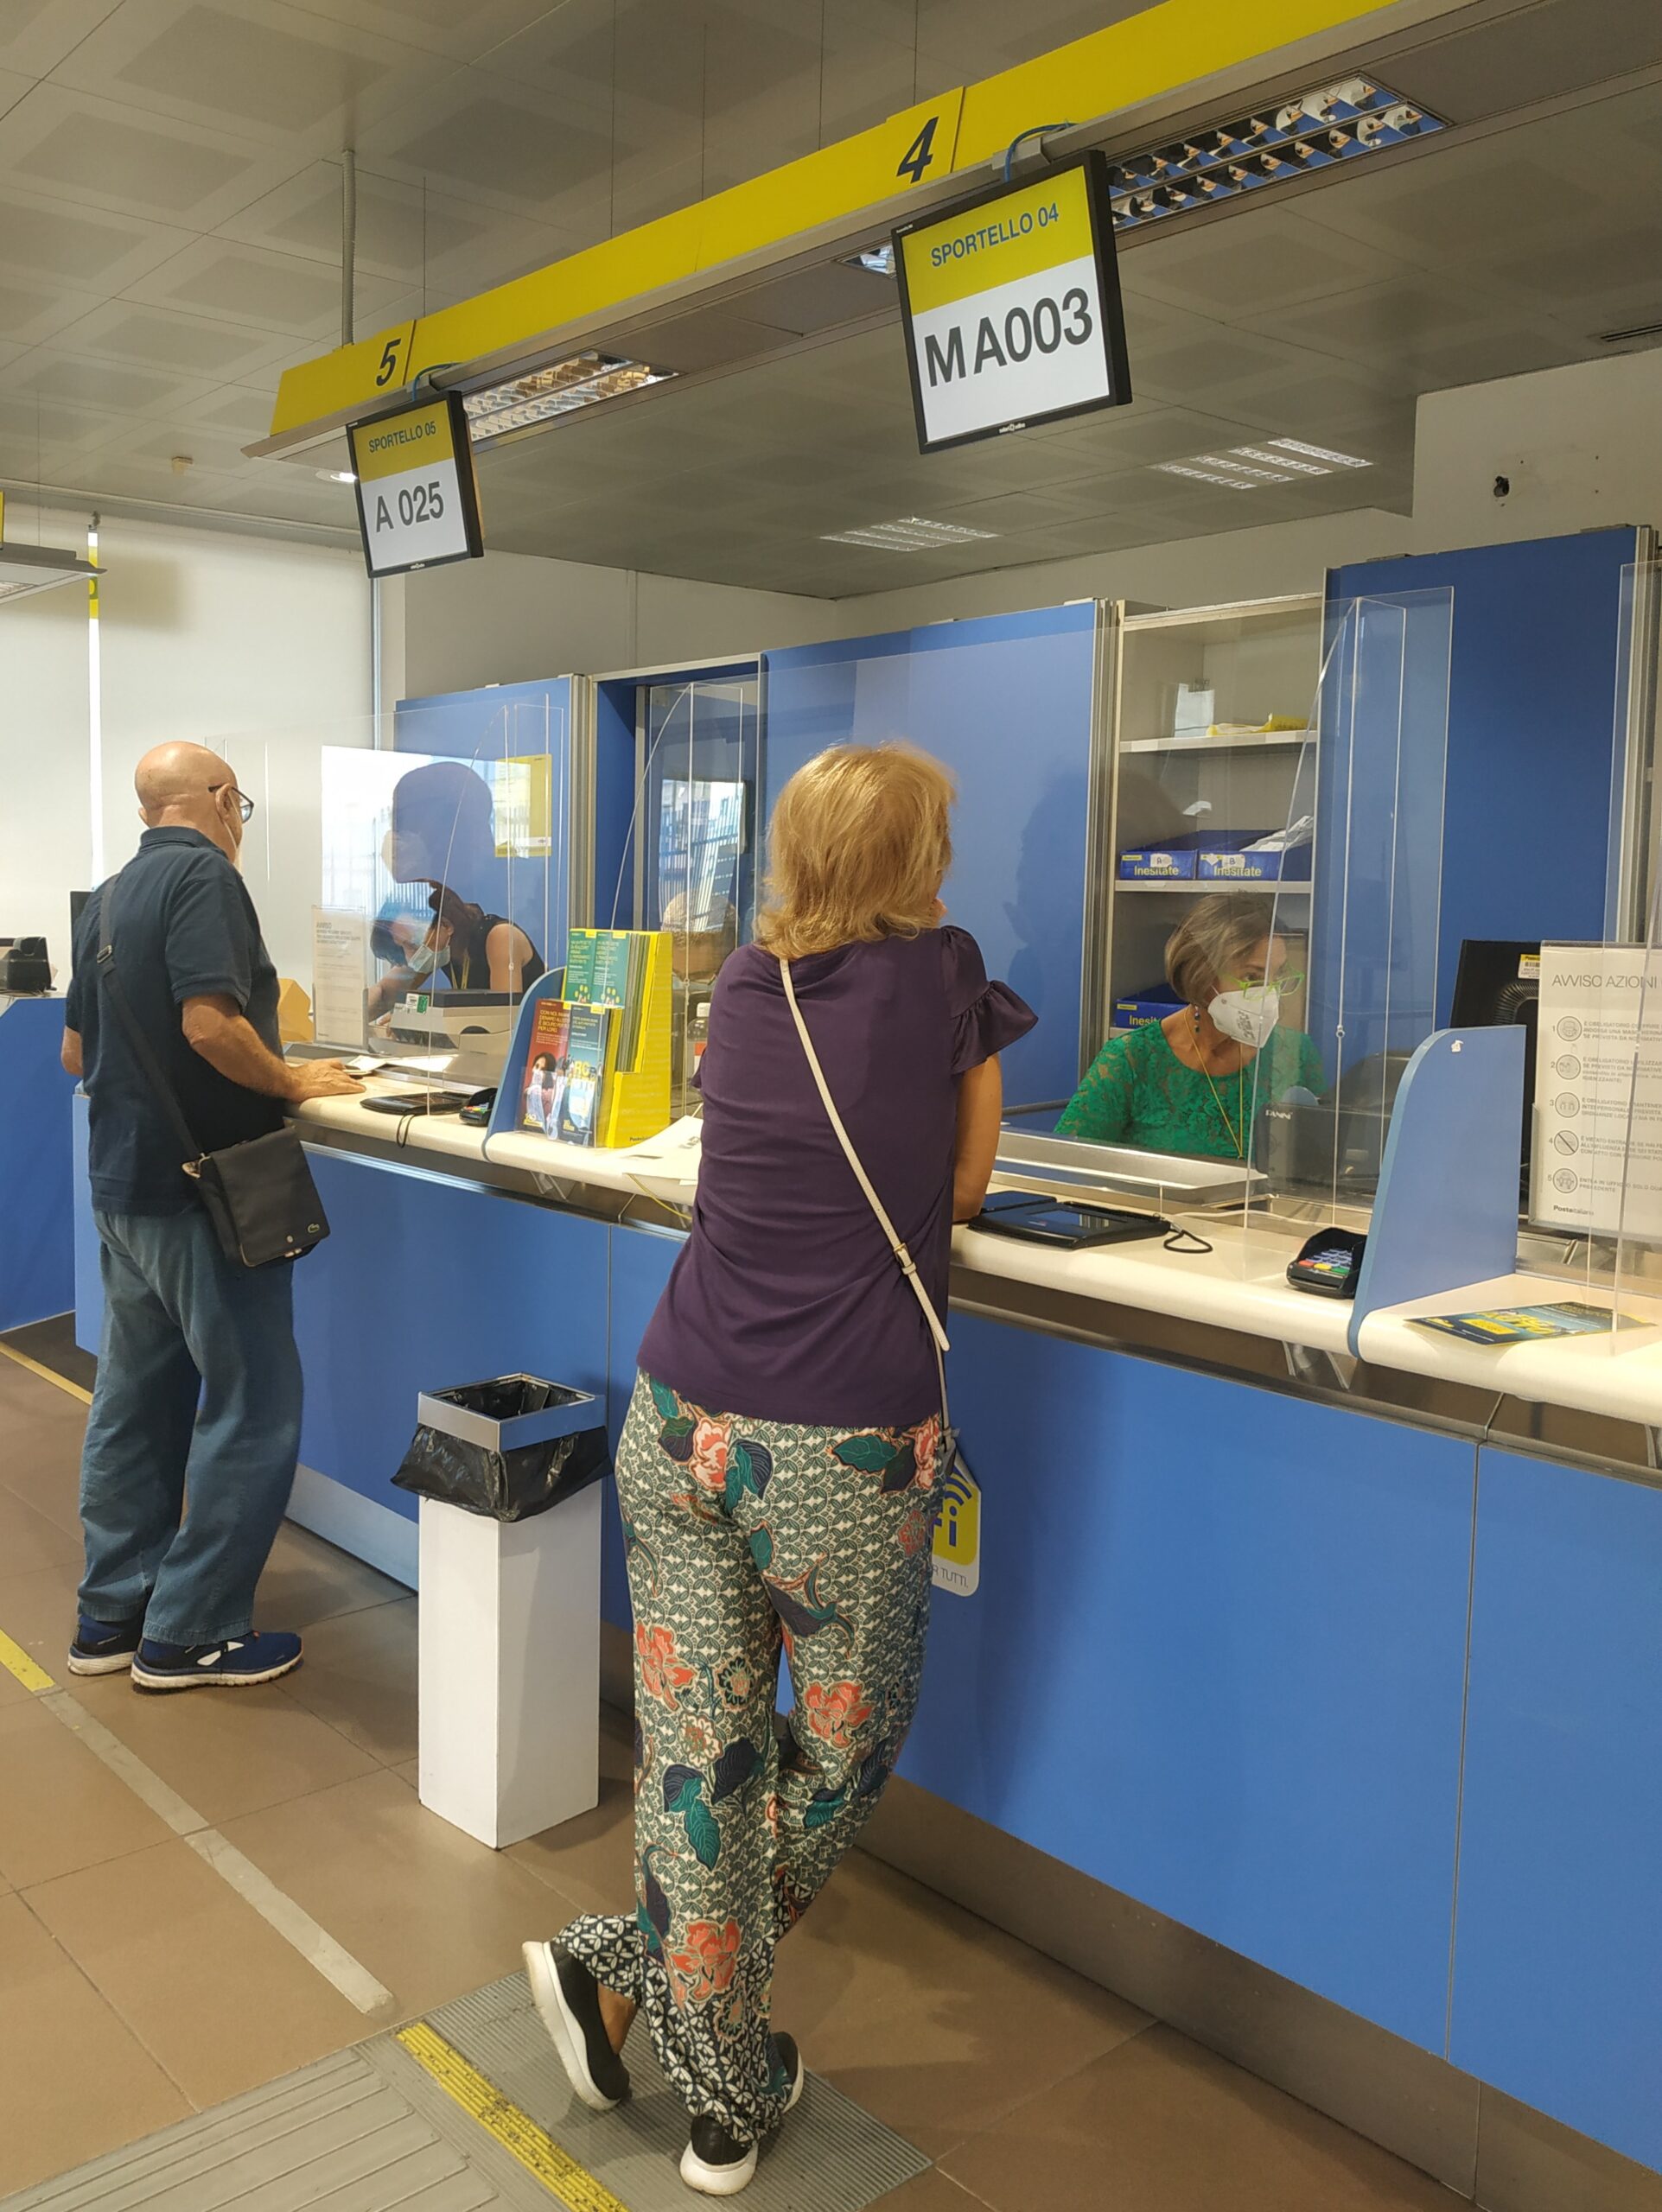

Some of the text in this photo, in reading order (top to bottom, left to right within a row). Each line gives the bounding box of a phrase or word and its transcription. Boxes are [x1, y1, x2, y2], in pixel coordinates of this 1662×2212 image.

[896, 116, 939, 183] 4
[931, 202, 1060, 267] SPORTELLO 04
[376, 338, 402, 386] 5
[368, 421, 436, 454] SPORTELLO 05
[375, 480, 444, 533] A 025
[1134, 865, 1180, 876] Inesitate
[1552, 975, 1602, 988] AVVISO
